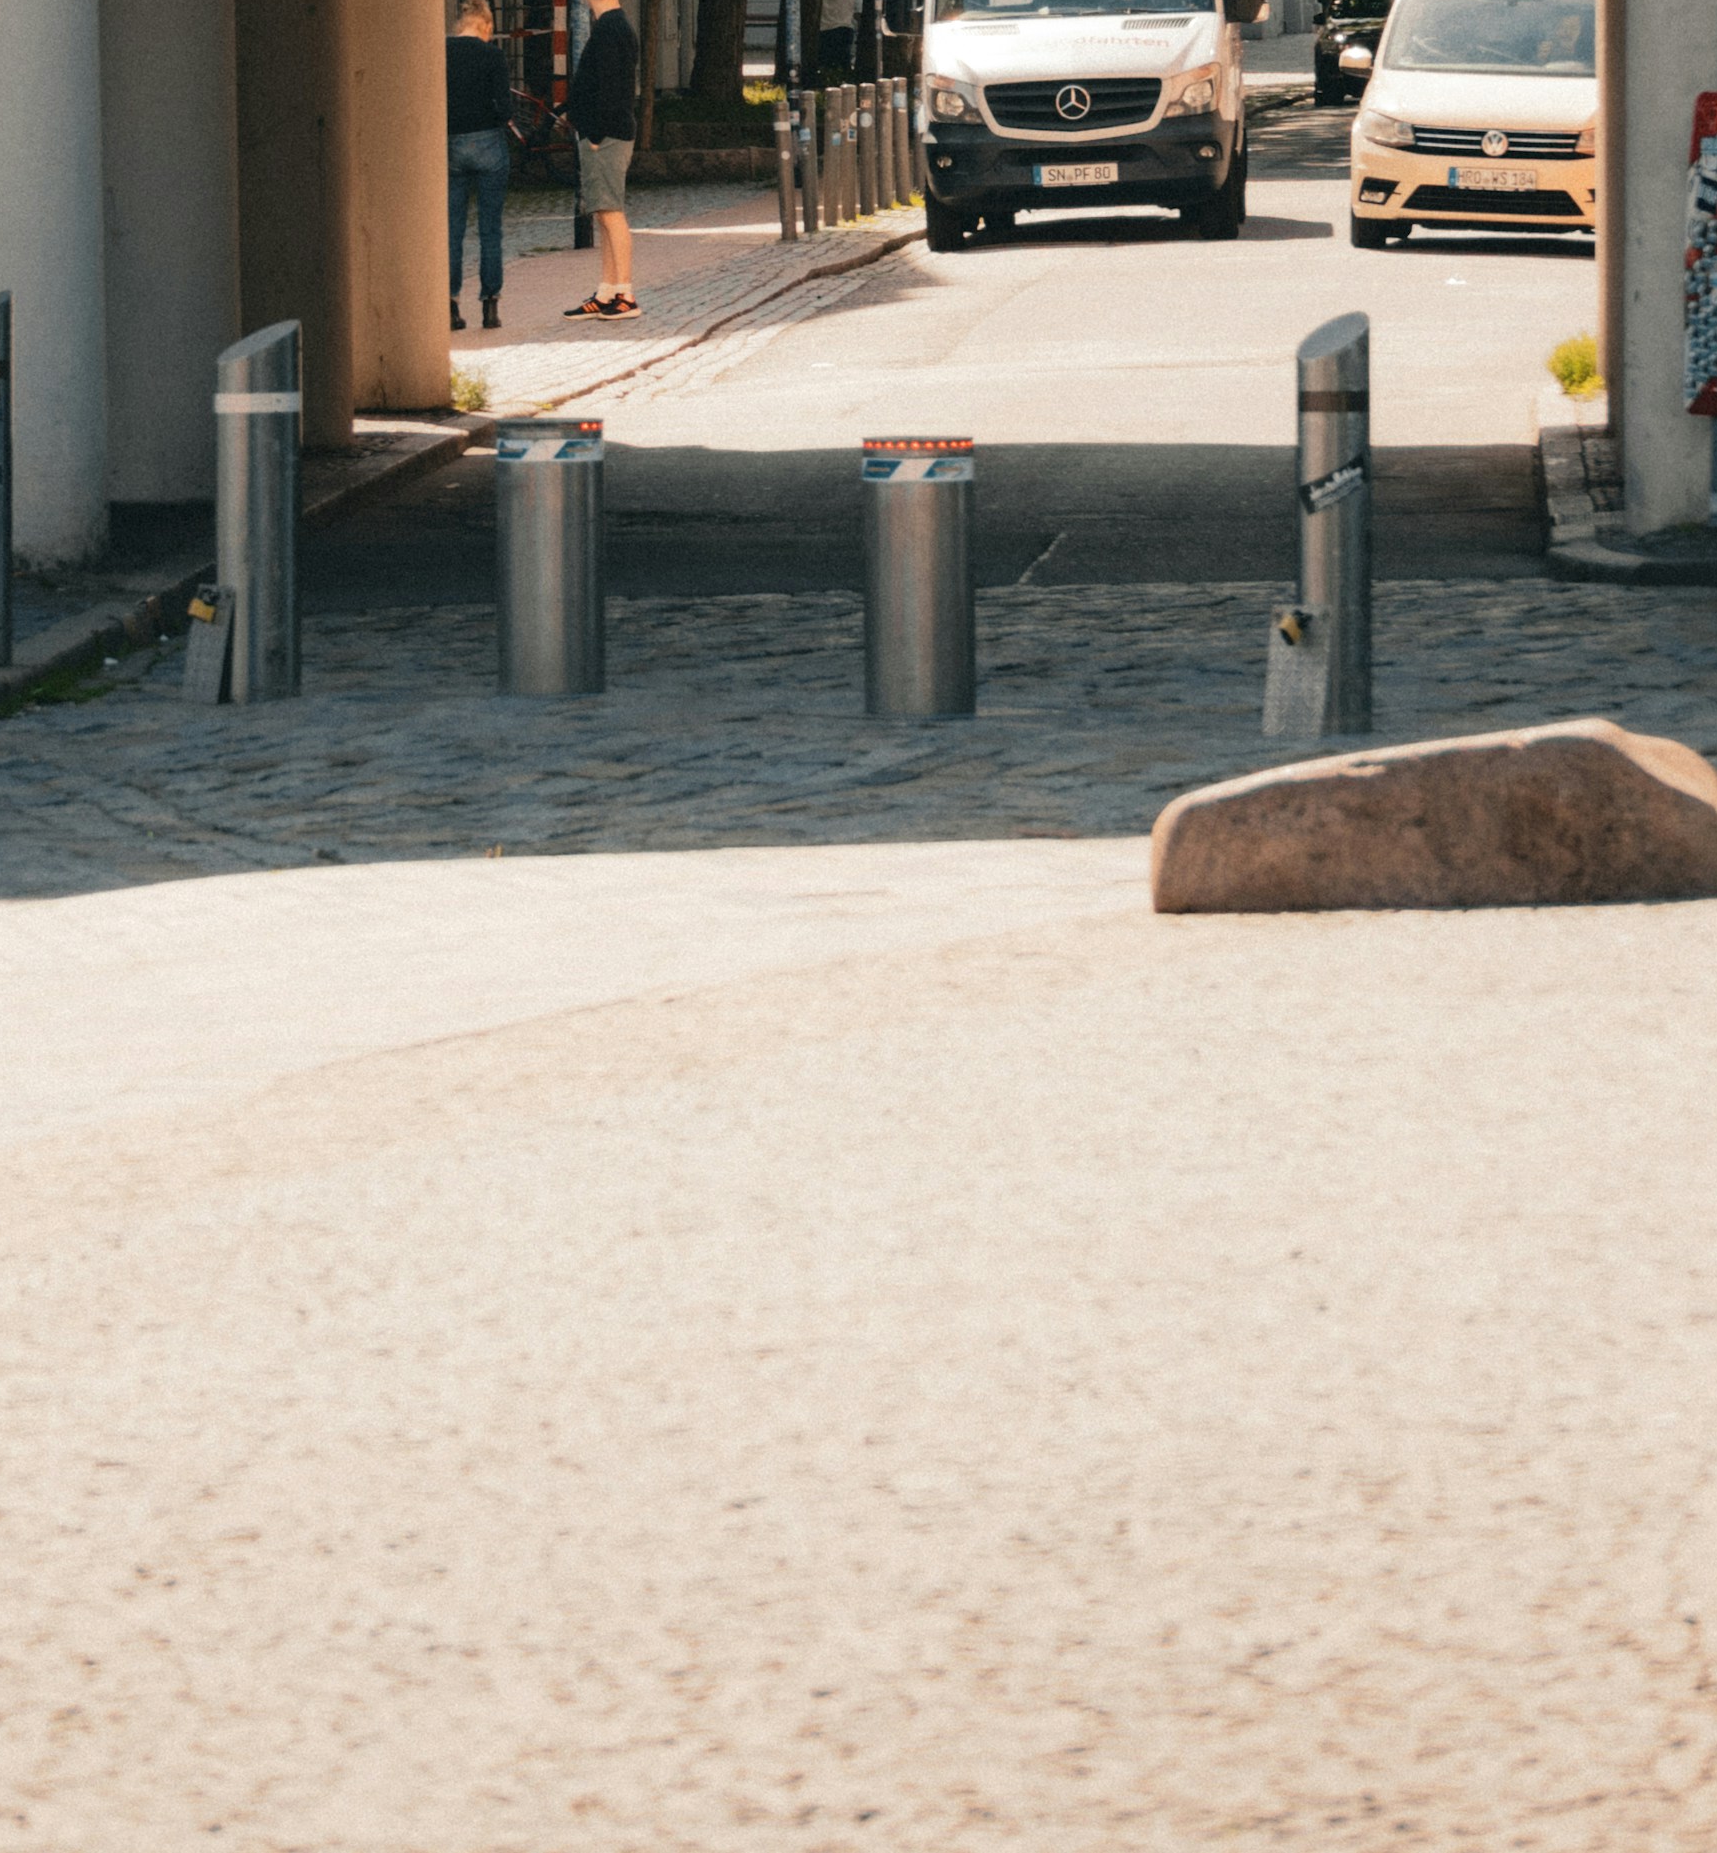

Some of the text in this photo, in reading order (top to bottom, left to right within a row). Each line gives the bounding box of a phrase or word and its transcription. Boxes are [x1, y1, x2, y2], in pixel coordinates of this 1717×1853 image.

[1047, 165, 1112, 181] SN PF 80
[1458, 170, 1483, 185] HRO
